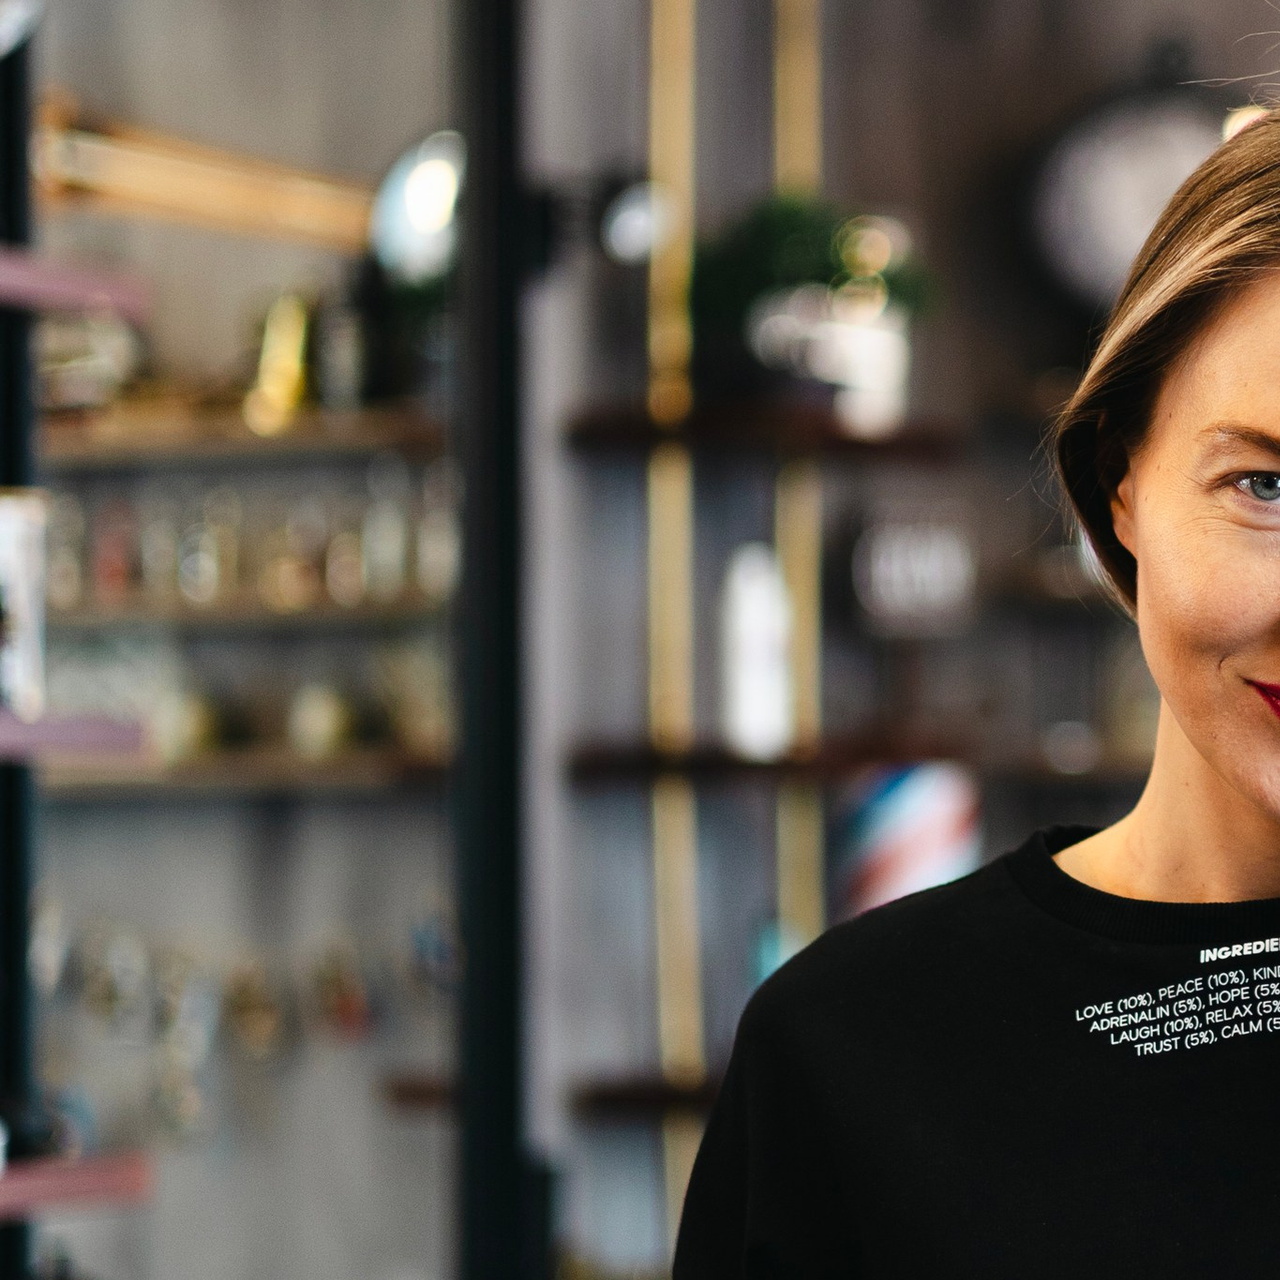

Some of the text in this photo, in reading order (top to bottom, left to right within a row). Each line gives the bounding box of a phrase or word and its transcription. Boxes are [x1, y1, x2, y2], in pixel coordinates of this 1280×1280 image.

[1075, 1001, 1114, 1021] LOVE
[1117, 992, 1156, 1013] (10%),
[1158, 977, 1204, 1001] PEACE
[1207, 969, 1249, 990] (10%),
[1089, 1004, 1170, 1033] ADRENALIN
[1173, 996, 1206, 1017] (5%),
[1208, 986, 1250, 1006] HOPE
[1110, 1024, 1160, 1045] LAUGH
[1164, 1015, 1203, 1036] (10%),
[1205, 1003, 1253, 1025] RELAX
[1134, 1037, 1181, 1056] TRUST
[1184, 1030, 1218, 1049] (5%),
[1221, 1020, 1263, 1039] CALM
